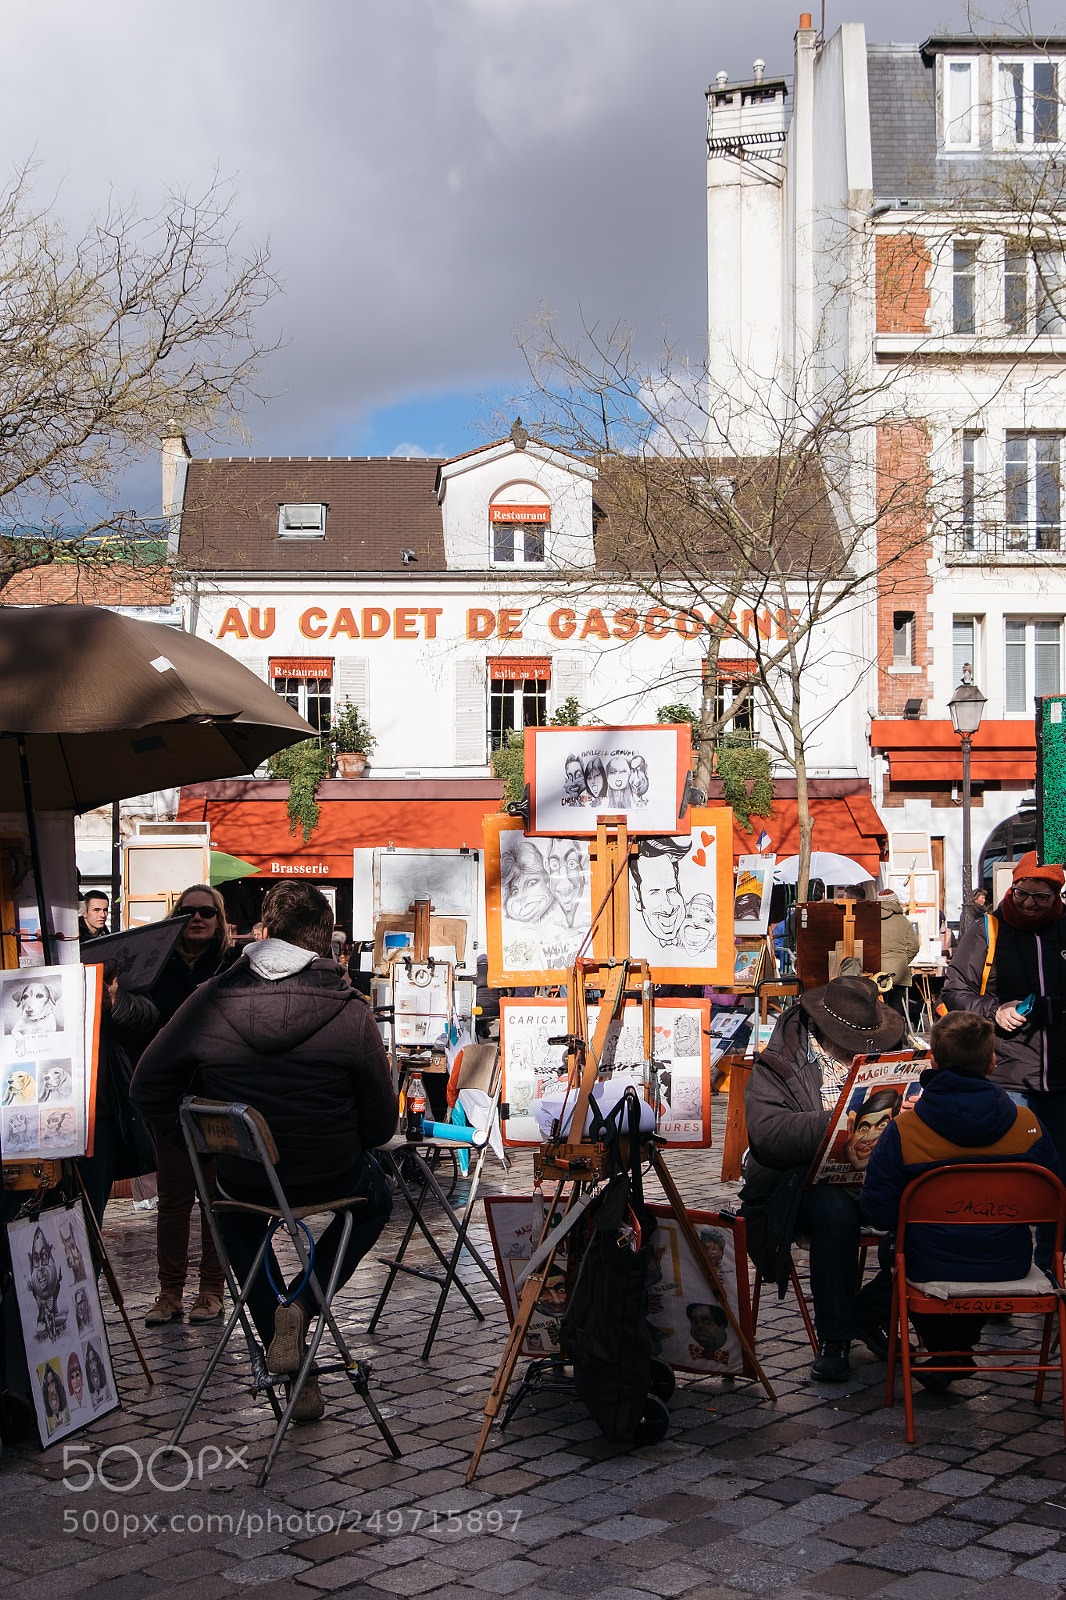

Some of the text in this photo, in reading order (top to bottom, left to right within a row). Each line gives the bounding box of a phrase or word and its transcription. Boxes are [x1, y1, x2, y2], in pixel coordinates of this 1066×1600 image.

[493, 510, 547, 520] Restaurant
[216, 607, 801, 641] AU CADET DE GASCOGNE
[274, 666, 328, 677] Restaurant
[494, 669, 516, 678] salle
[271, 862, 329, 874] Brasserie
[508, 1015, 601, 1025] CARICATES
[857, 1066, 889, 1083] MAGIC
[945, 1200, 1019, 1217] JACQUES
[943, 1301, 1014, 1311] JACQUES
